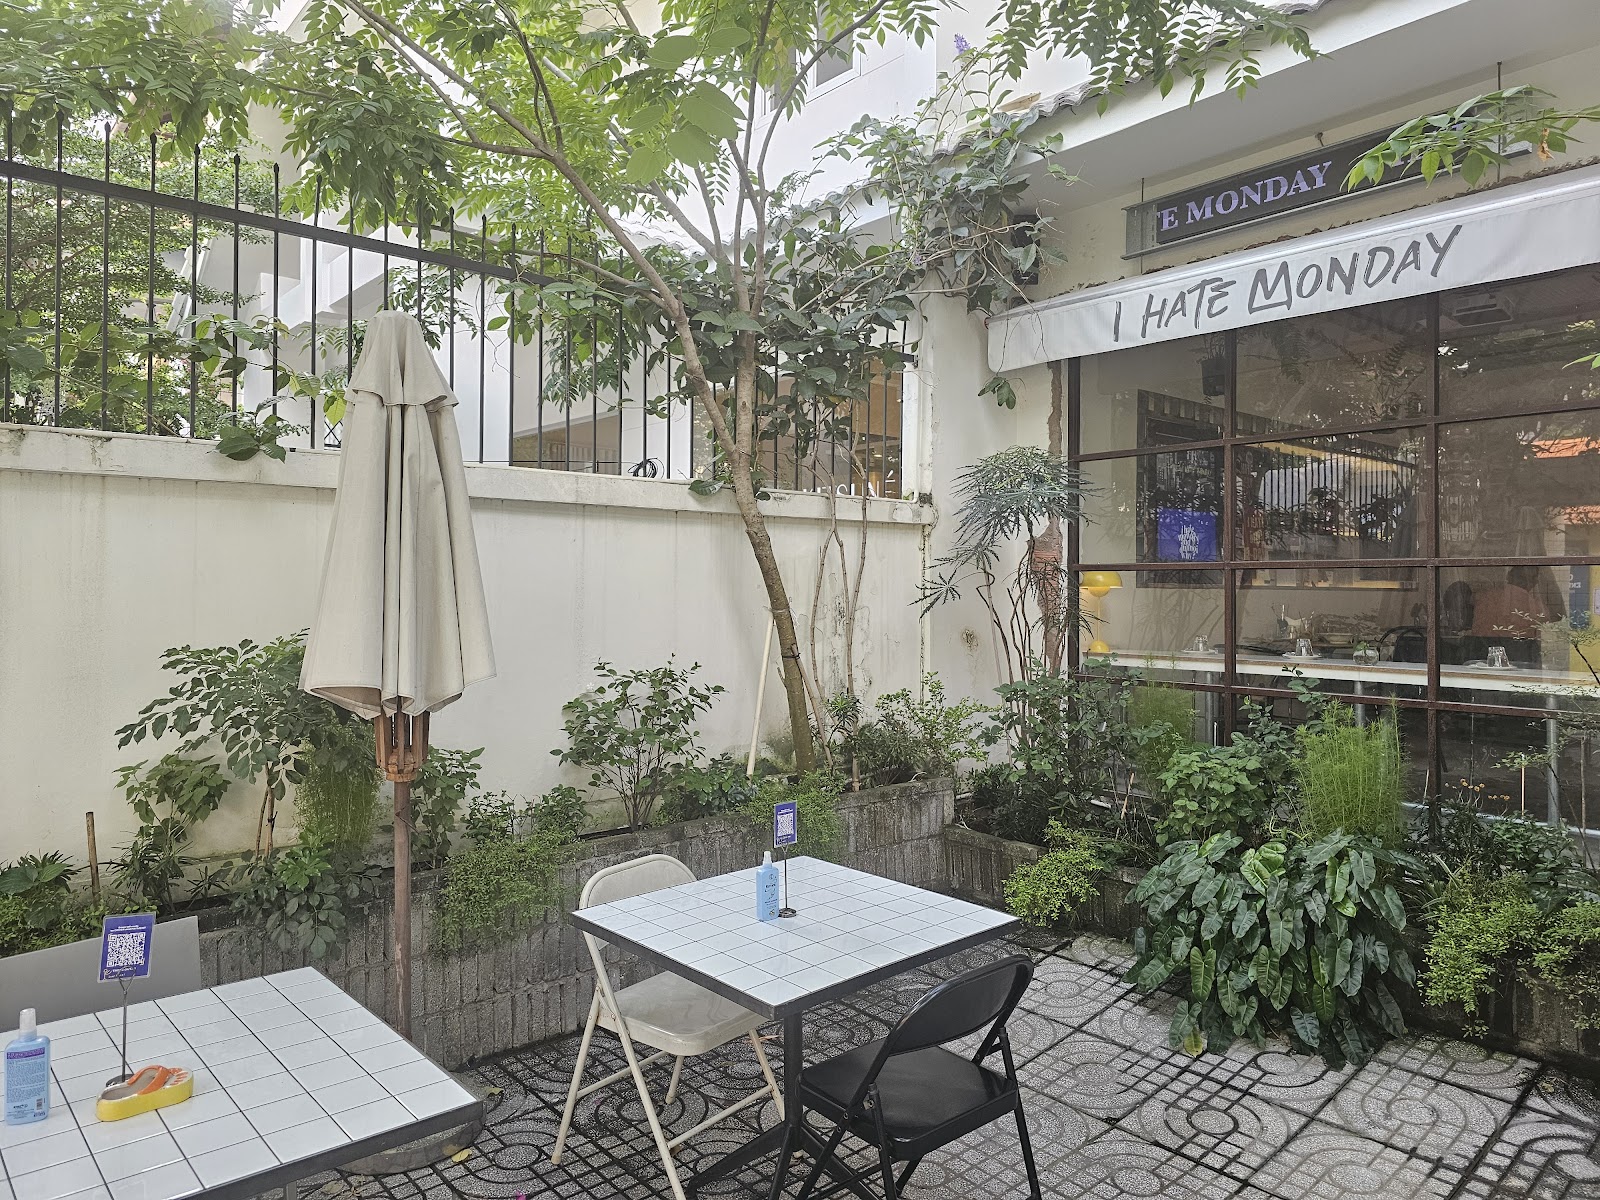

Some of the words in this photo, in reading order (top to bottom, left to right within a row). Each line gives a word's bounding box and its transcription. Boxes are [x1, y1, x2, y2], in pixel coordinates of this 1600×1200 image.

[1156, 206, 1179, 232] E
[1186, 161, 1332, 225] MONDAY
[1113, 301, 1122, 342] I
[1141, 277, 1237, 338] HATE
[1248, 225, 1463, 314] MONDAY
